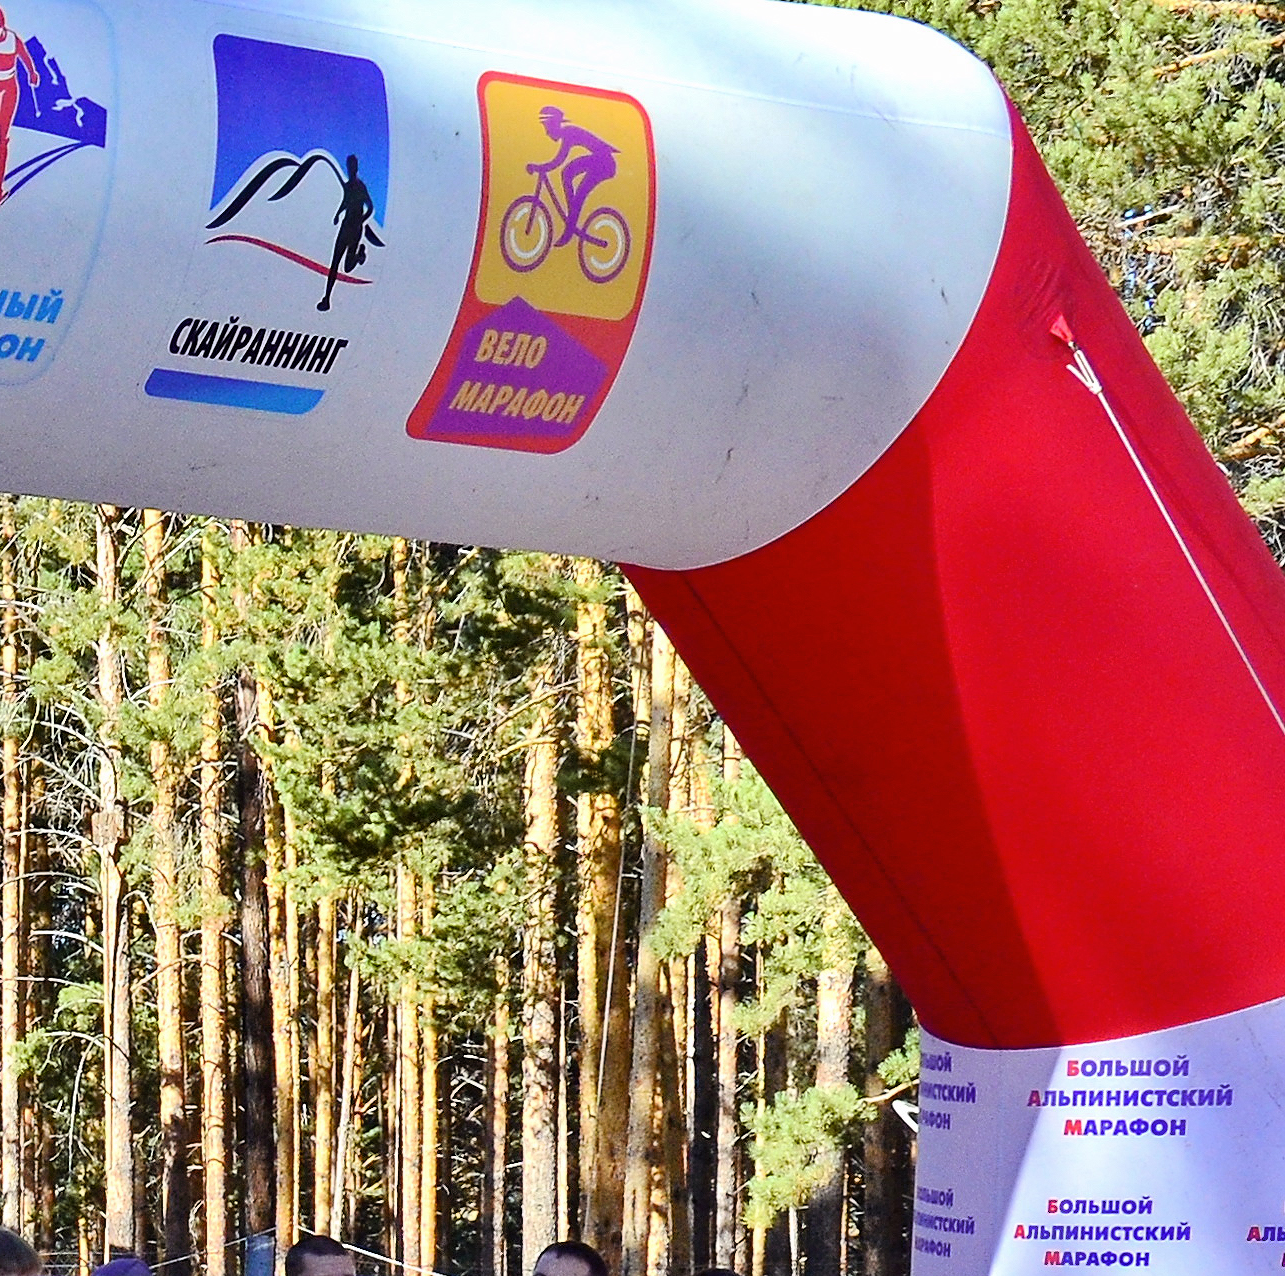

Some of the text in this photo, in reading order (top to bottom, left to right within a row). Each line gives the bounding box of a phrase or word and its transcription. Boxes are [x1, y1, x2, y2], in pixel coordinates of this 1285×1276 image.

[169, 316, 349, 374] СКАЙРАННИНГ
[474, 328, 548, 368] ВЕЛО
[449, 380, 585, 424] МАРАФОН
[1067, 1055, 1190, 1076] БОЛЬШОЙ
[1027, 1084, 1234, 1107] АЛЬПИНИСТСКИЙ
[1063, 1118, 1187, 1136] МАРАФОН
[1047, 1195, 1153, 1214] БОЛЬШОЙ
[1014, 1221, 1191, 1241] АЛЬПИНИСТСКИЙ
[1044, 1250, 1150, 1267] МАРАФОН
